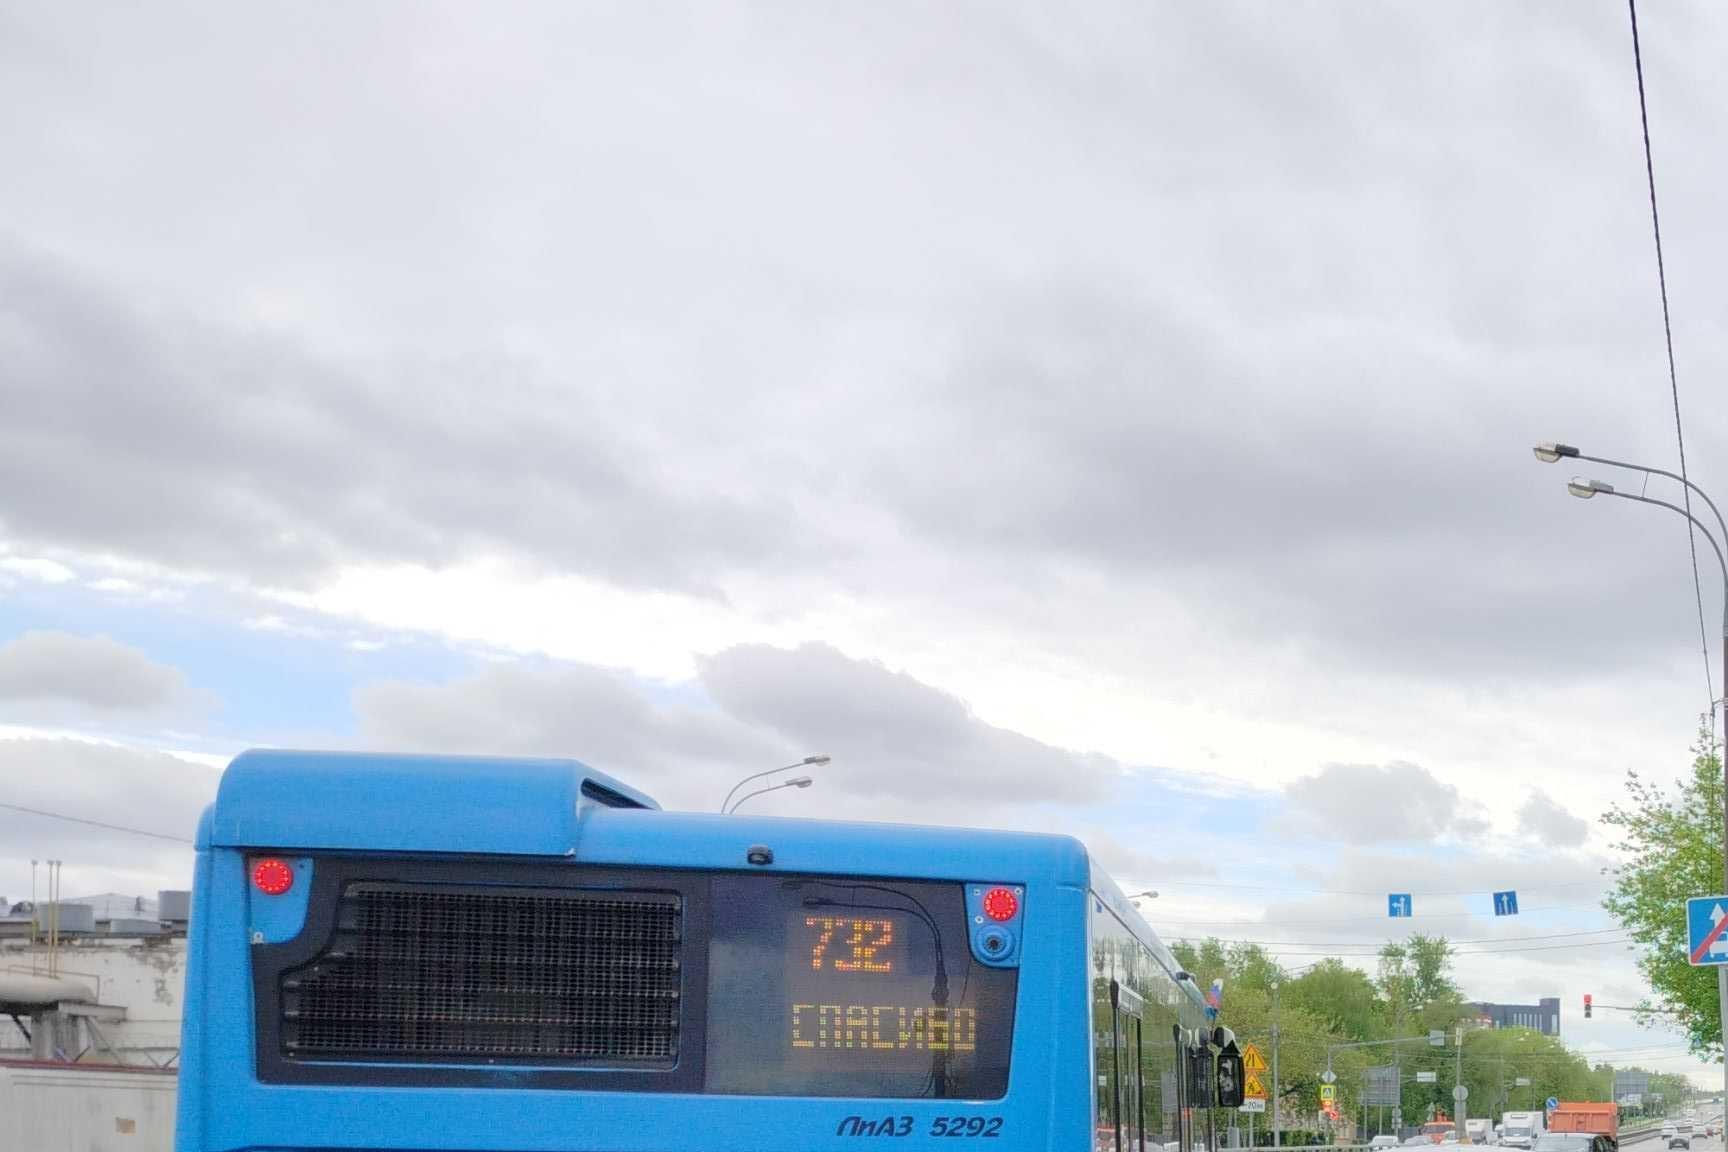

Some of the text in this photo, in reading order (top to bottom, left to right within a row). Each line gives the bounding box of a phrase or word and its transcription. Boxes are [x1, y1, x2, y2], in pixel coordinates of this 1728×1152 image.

[806, 916, 893, 973] 732
[792, 1003, 976, 1050] СПАСИБО
[835, 1116, 1004, 1138] ЛиАЗ 5292
